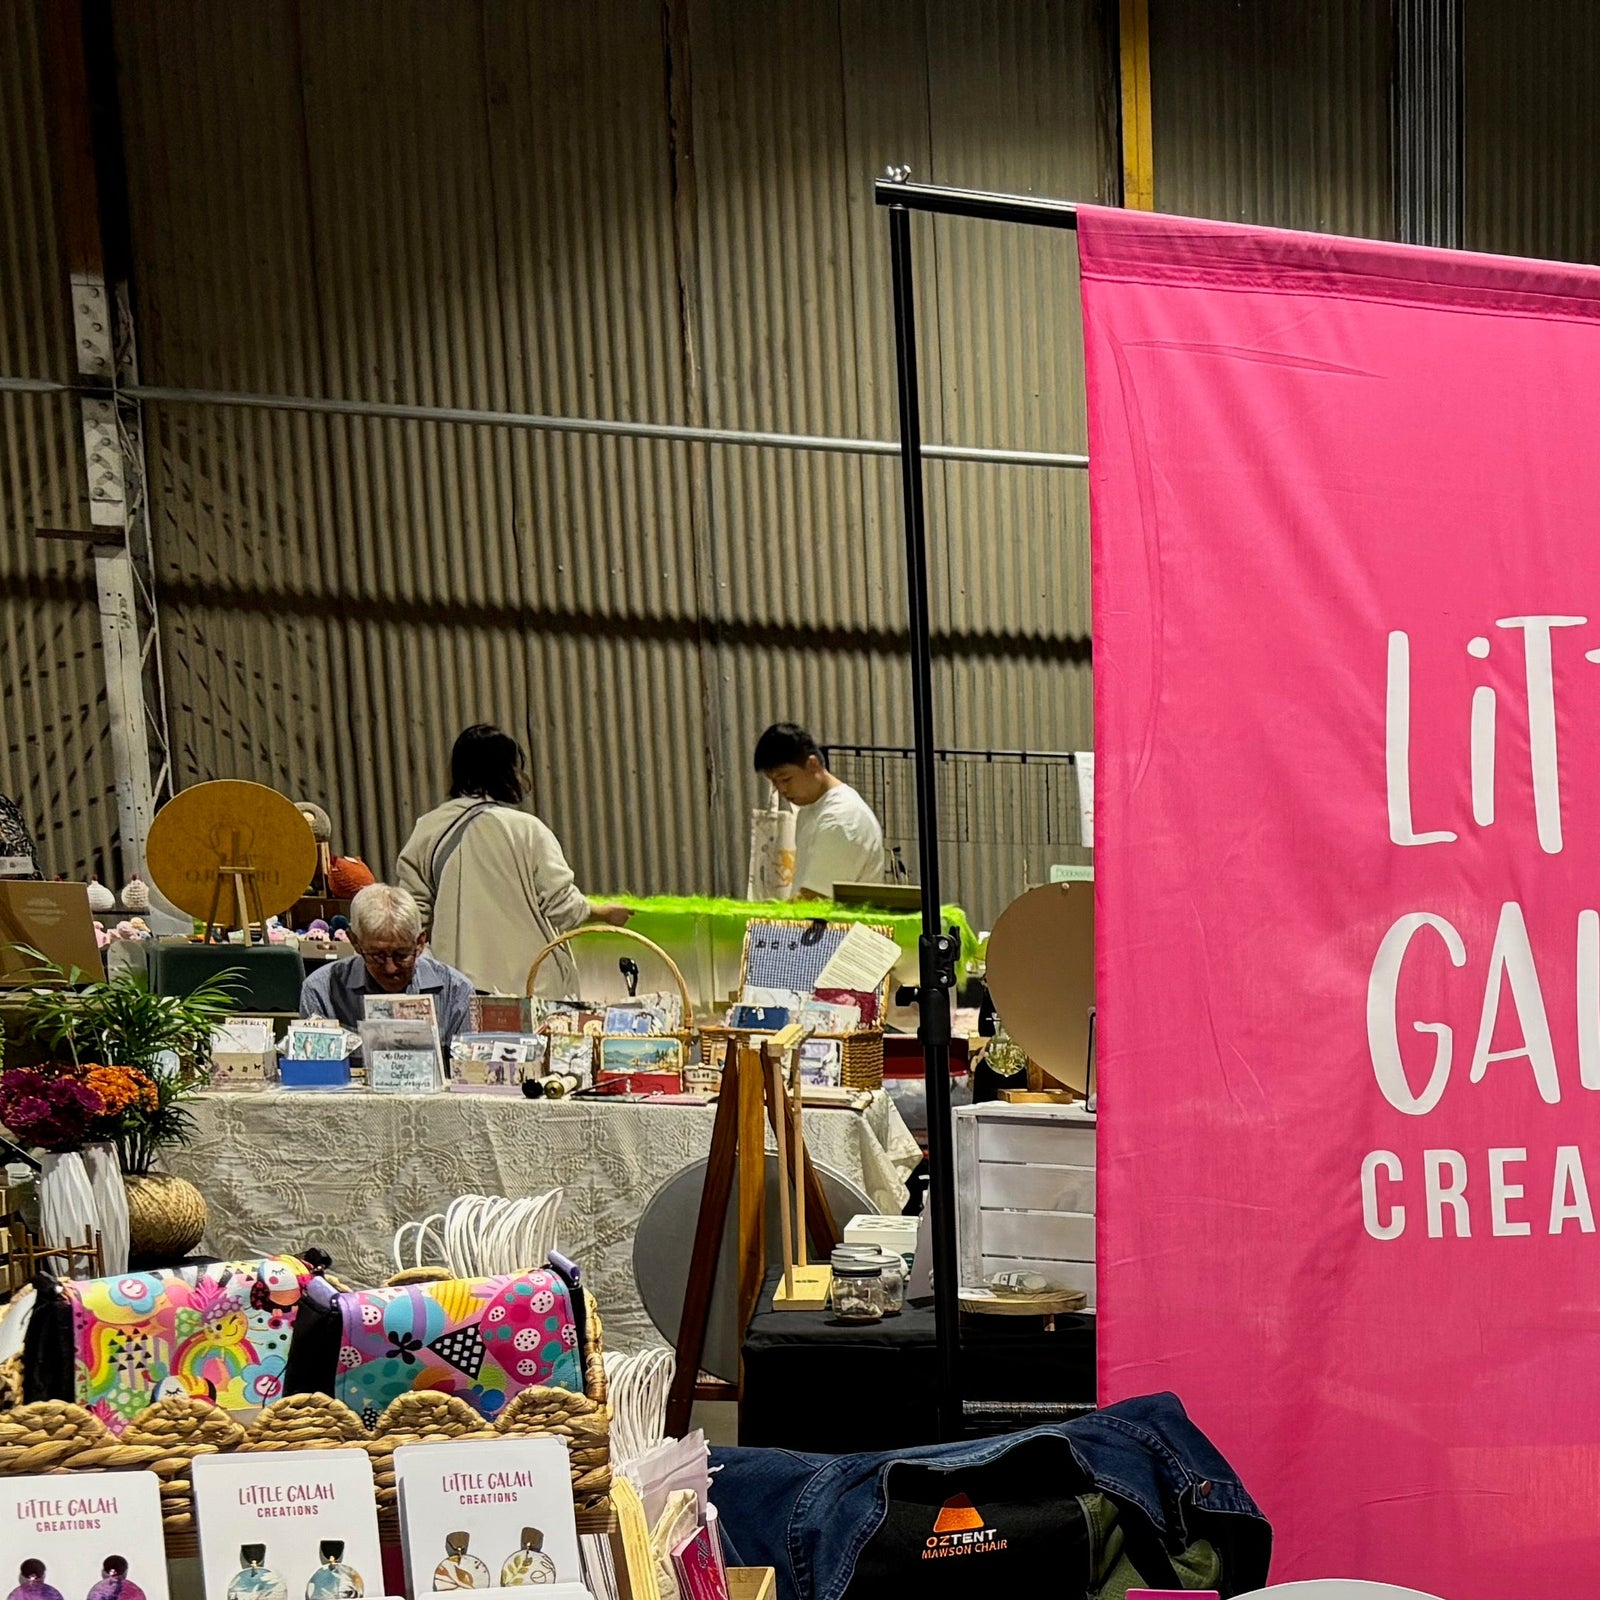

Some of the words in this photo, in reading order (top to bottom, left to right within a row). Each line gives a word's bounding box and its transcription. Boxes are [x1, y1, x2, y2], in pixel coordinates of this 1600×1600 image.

[488, 1470, 533, 1490] GALAH
[287, 1483, 335, 1502] GALAH
[460, 1492, 518, 1504] CREATIONS
[68, 1497, 118, 1516] GALAH
[257, 1505, 319, 1518] CREATIONS
[36, 1519, 101, 1532] CREATIONS
[926, 1529, 997, 1548] OZTENT
[921, 1544, 972, 1559] MAWSON
[975, 1539, 1008, 1553] CHAIR
